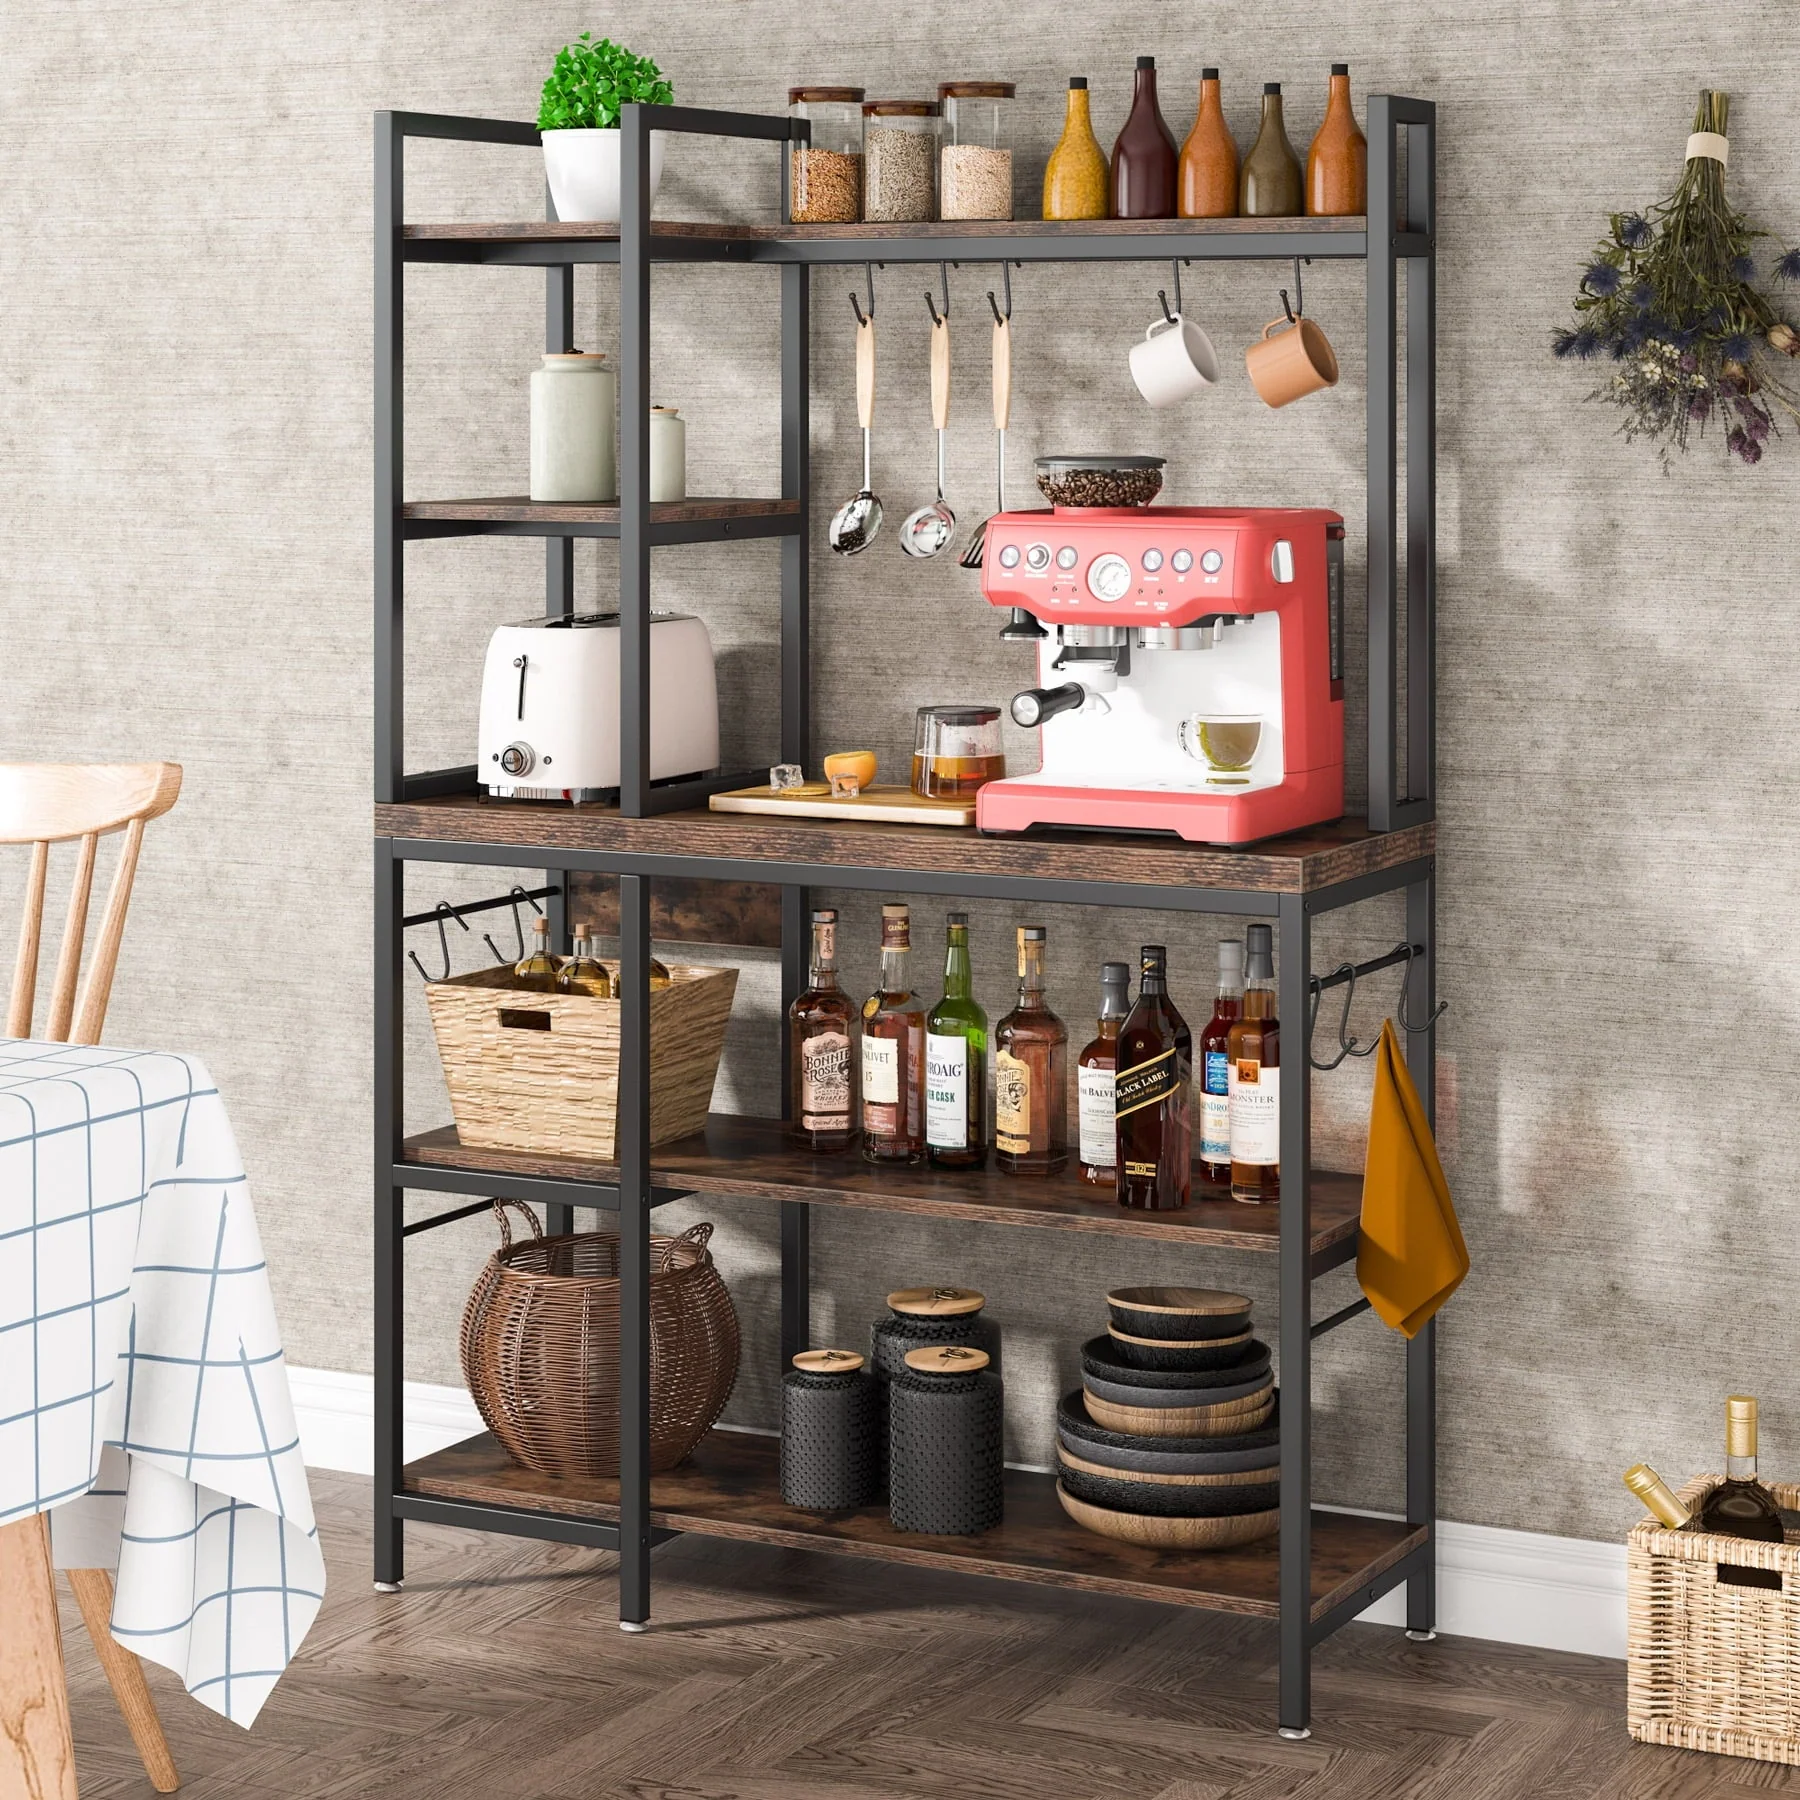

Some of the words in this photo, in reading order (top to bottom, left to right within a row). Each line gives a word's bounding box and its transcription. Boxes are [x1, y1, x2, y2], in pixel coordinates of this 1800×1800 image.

[806, 1050, 850, 1070] BONNIE
[809, 1064, 838, 1082] ROSE
[1141, 1070, 1169, 1087] LABEL
[935, 1090, 955, 1103] CASK
[1230, 1091, 1275, 1103] MONSTER
